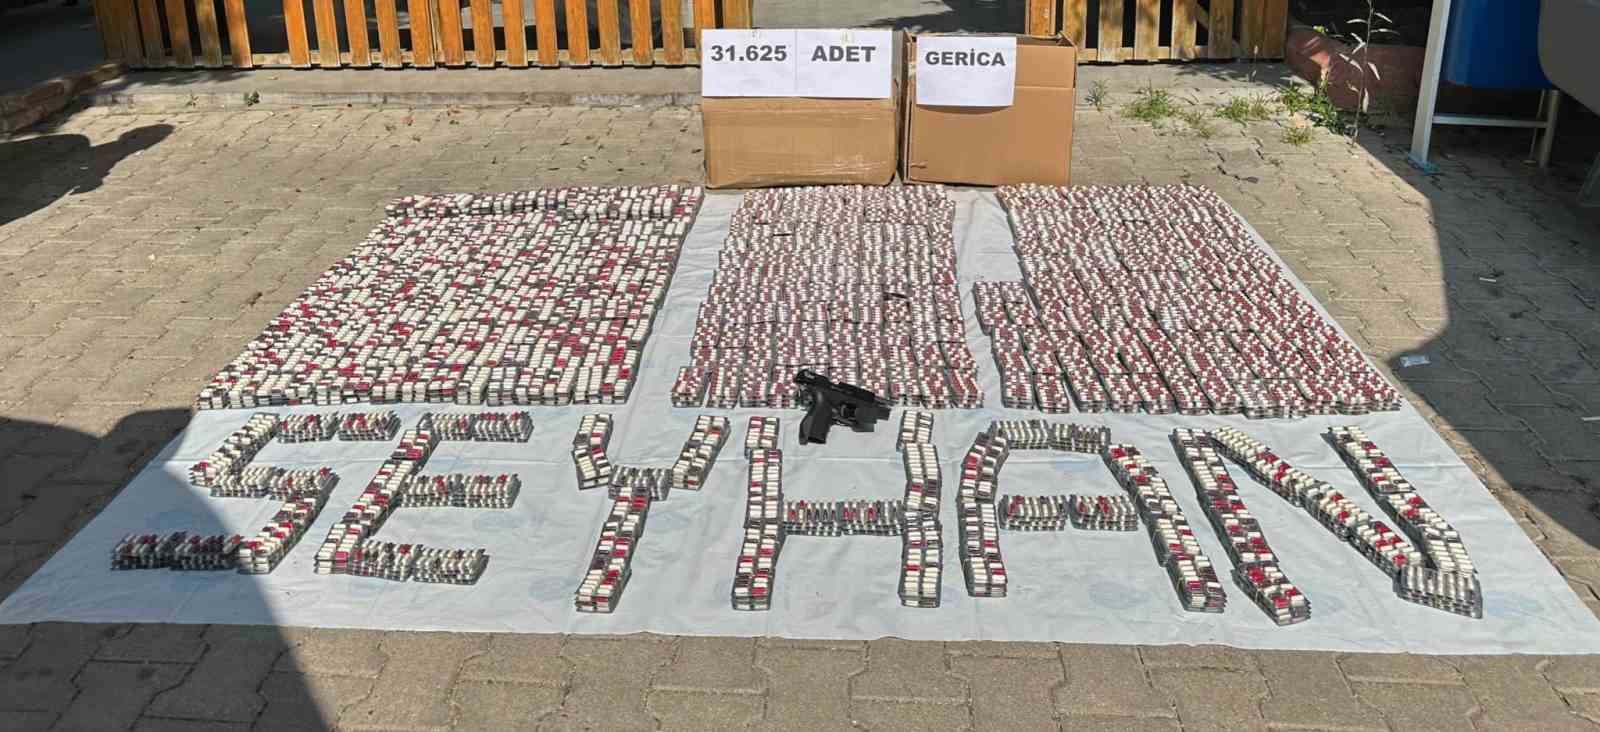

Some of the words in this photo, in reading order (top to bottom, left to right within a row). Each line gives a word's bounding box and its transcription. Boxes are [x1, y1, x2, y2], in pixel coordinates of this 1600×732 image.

[711, 45, 788, 62] 31.625
[811, 45, 876, 63] ADET
[925, 50, 1006, 67] GERİCA
[111, 410, 1483, 625] SEYHAN
